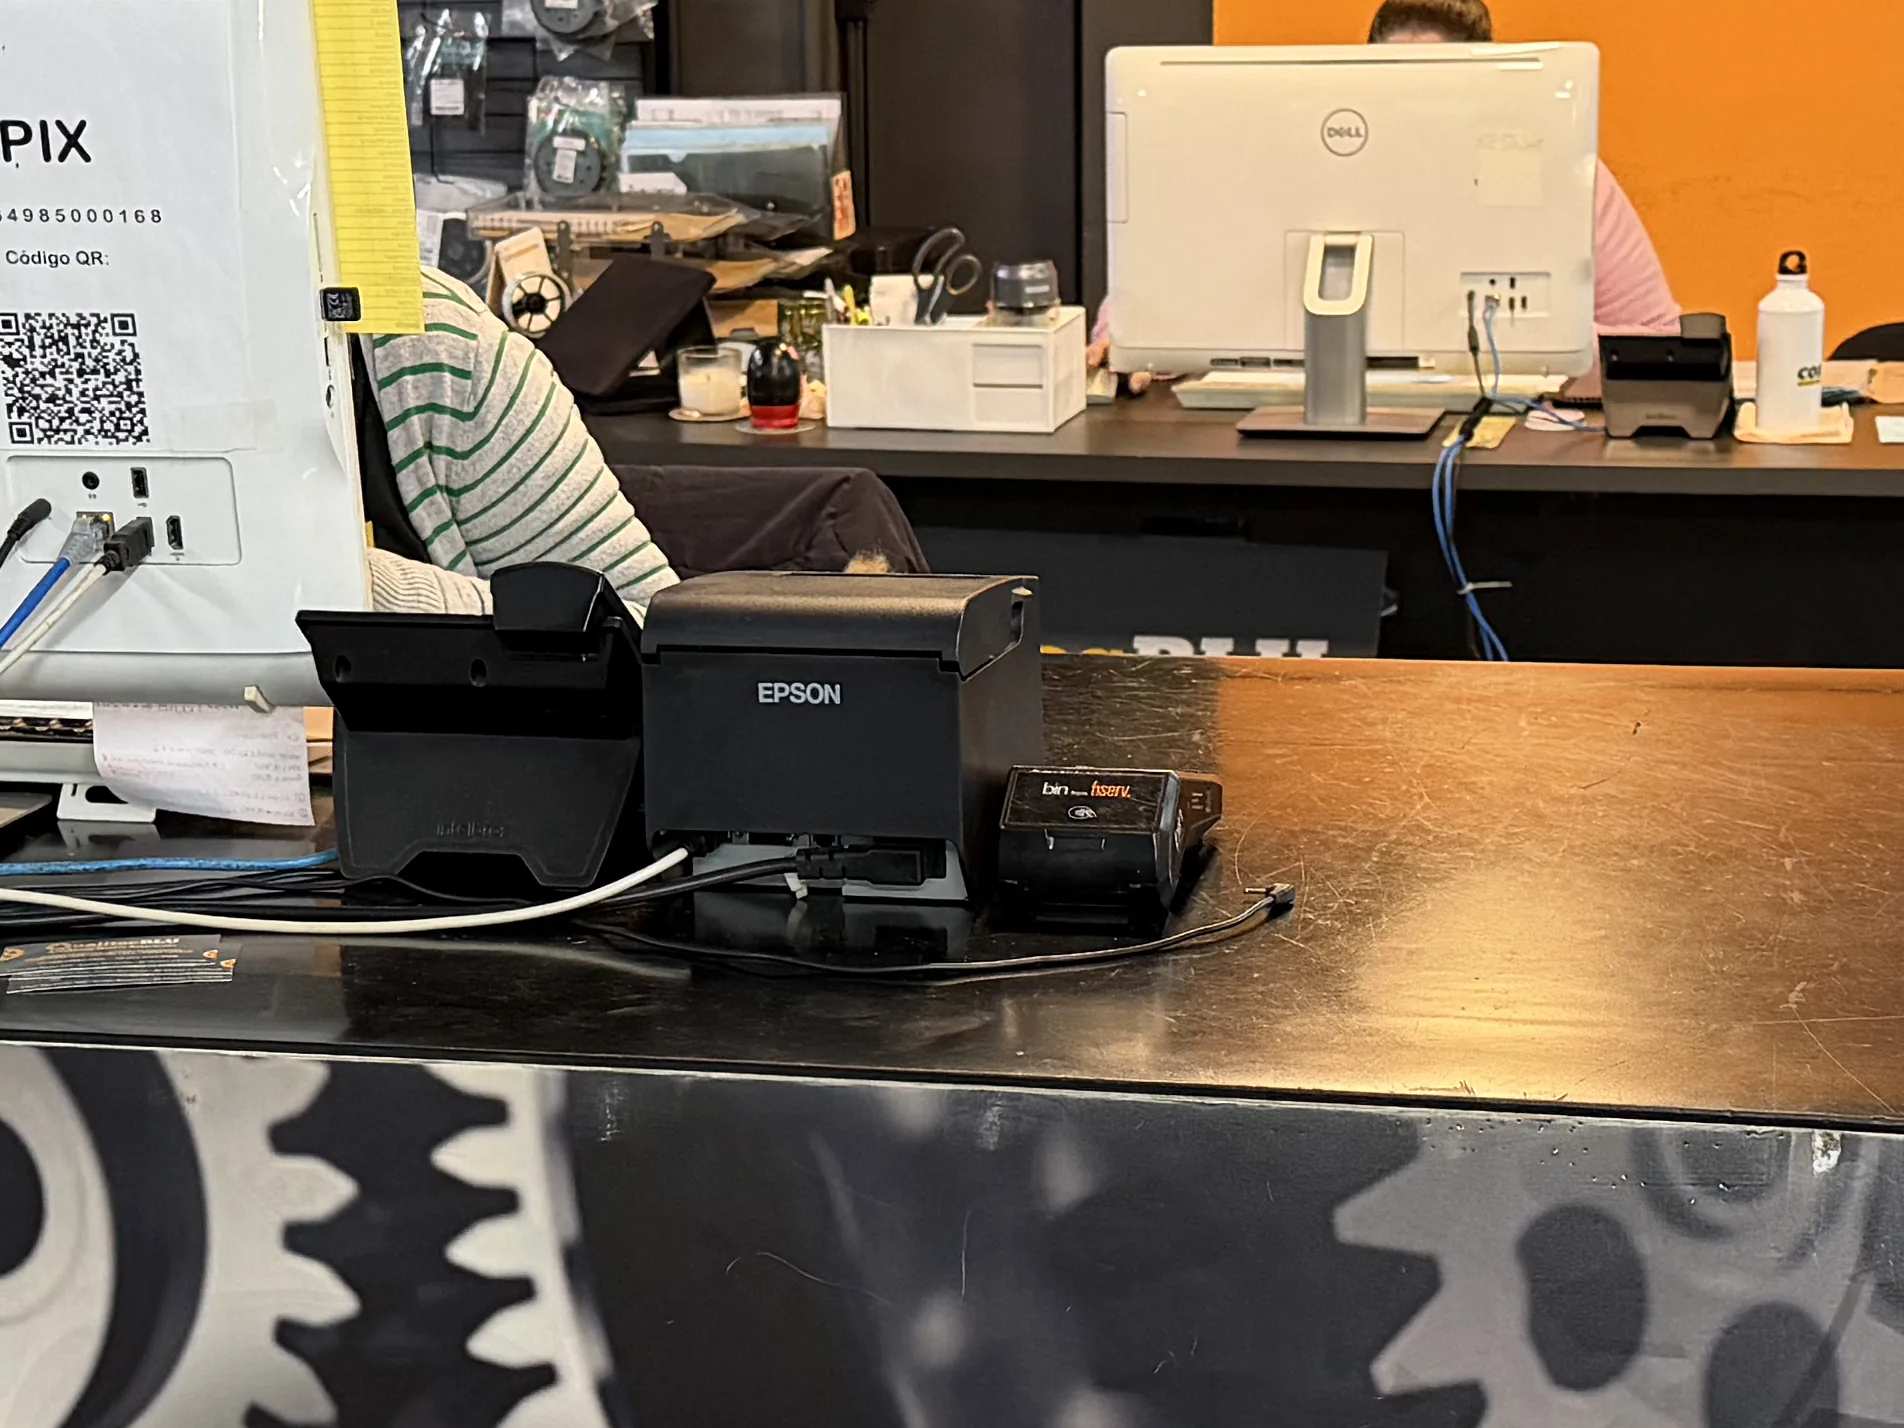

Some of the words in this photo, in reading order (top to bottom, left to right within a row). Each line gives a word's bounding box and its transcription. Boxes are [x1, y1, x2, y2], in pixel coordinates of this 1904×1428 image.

[0, 119, 92, 164] PIX
[1326, 126, 1364, 139] DELL
[5, 250, 70, 268] Código
[75, 250, 110, 266] QR:
[757, 681, 841, 706] EPSON
[1042, 781, 1069, 796] bin
